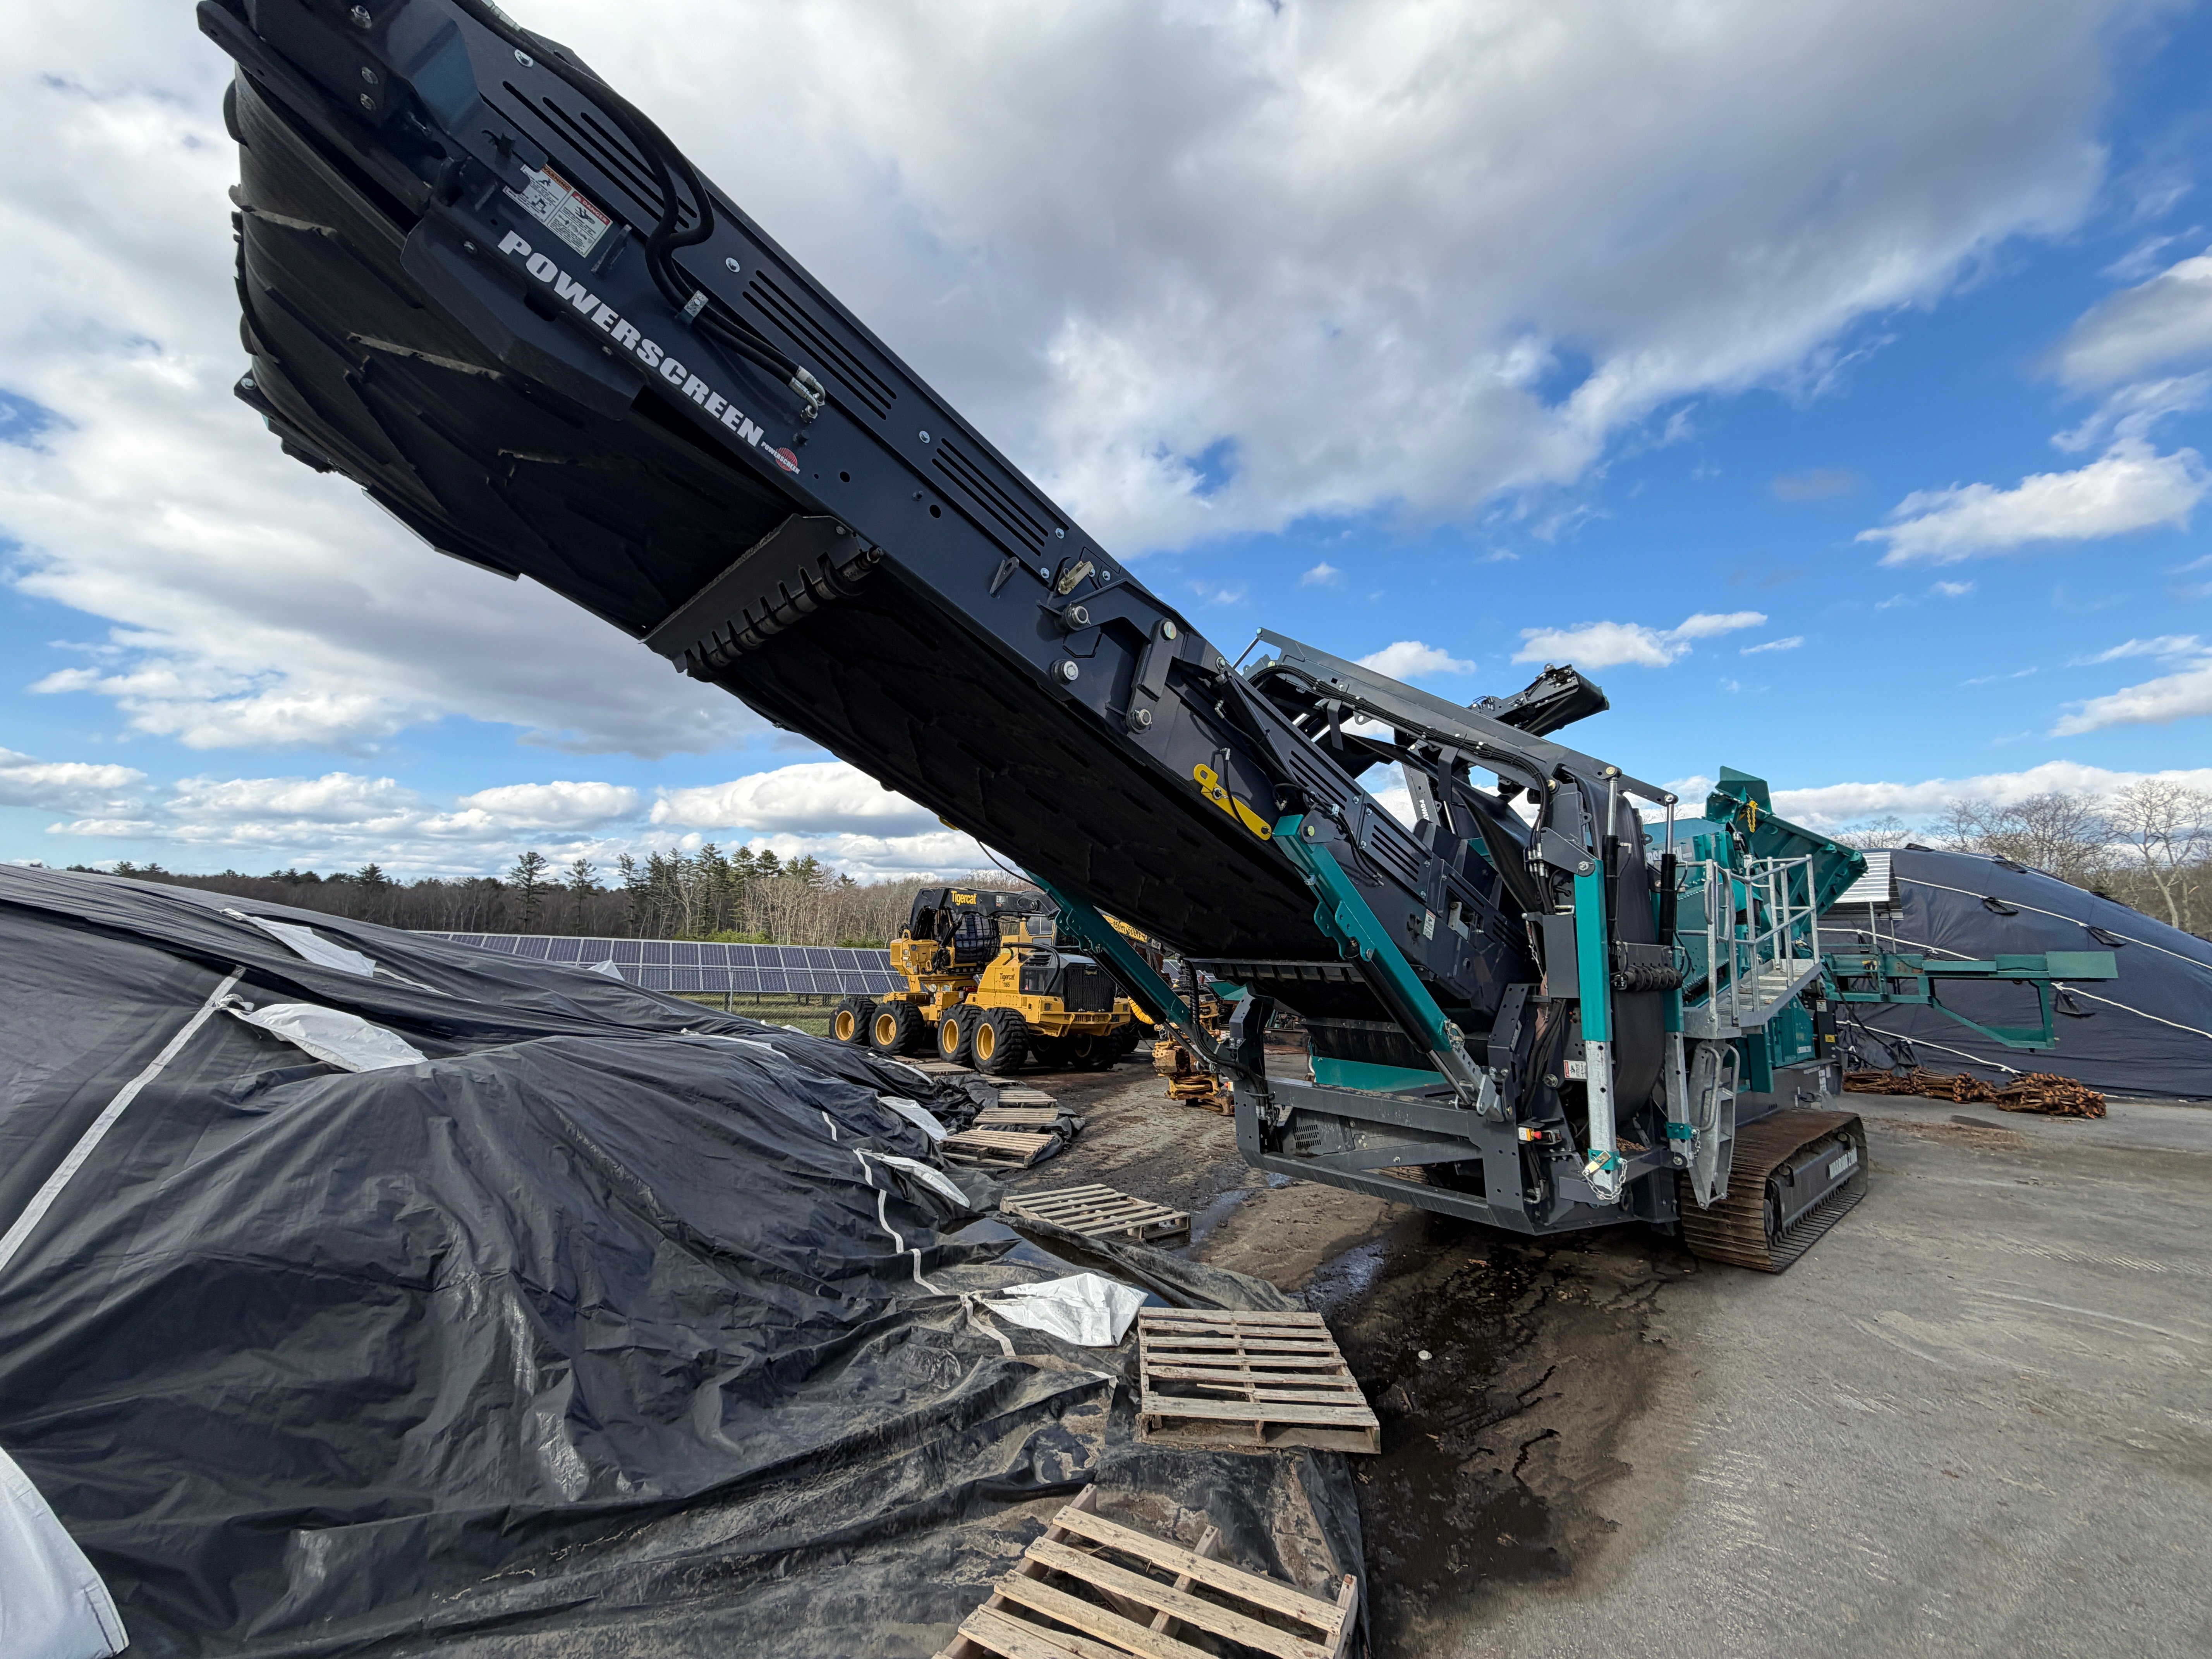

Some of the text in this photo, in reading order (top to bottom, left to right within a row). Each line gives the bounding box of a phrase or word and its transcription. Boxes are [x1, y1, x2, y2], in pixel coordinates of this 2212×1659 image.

[582, 200, 607, 222] DANGER
[497, 230, 764, 447] POWERSCREEN
[761, 441, 800, 475] POWERSCREEN
[951, 890, 977, 907] Tigercat
[1000, 973, 1015, 981] Tigercat
